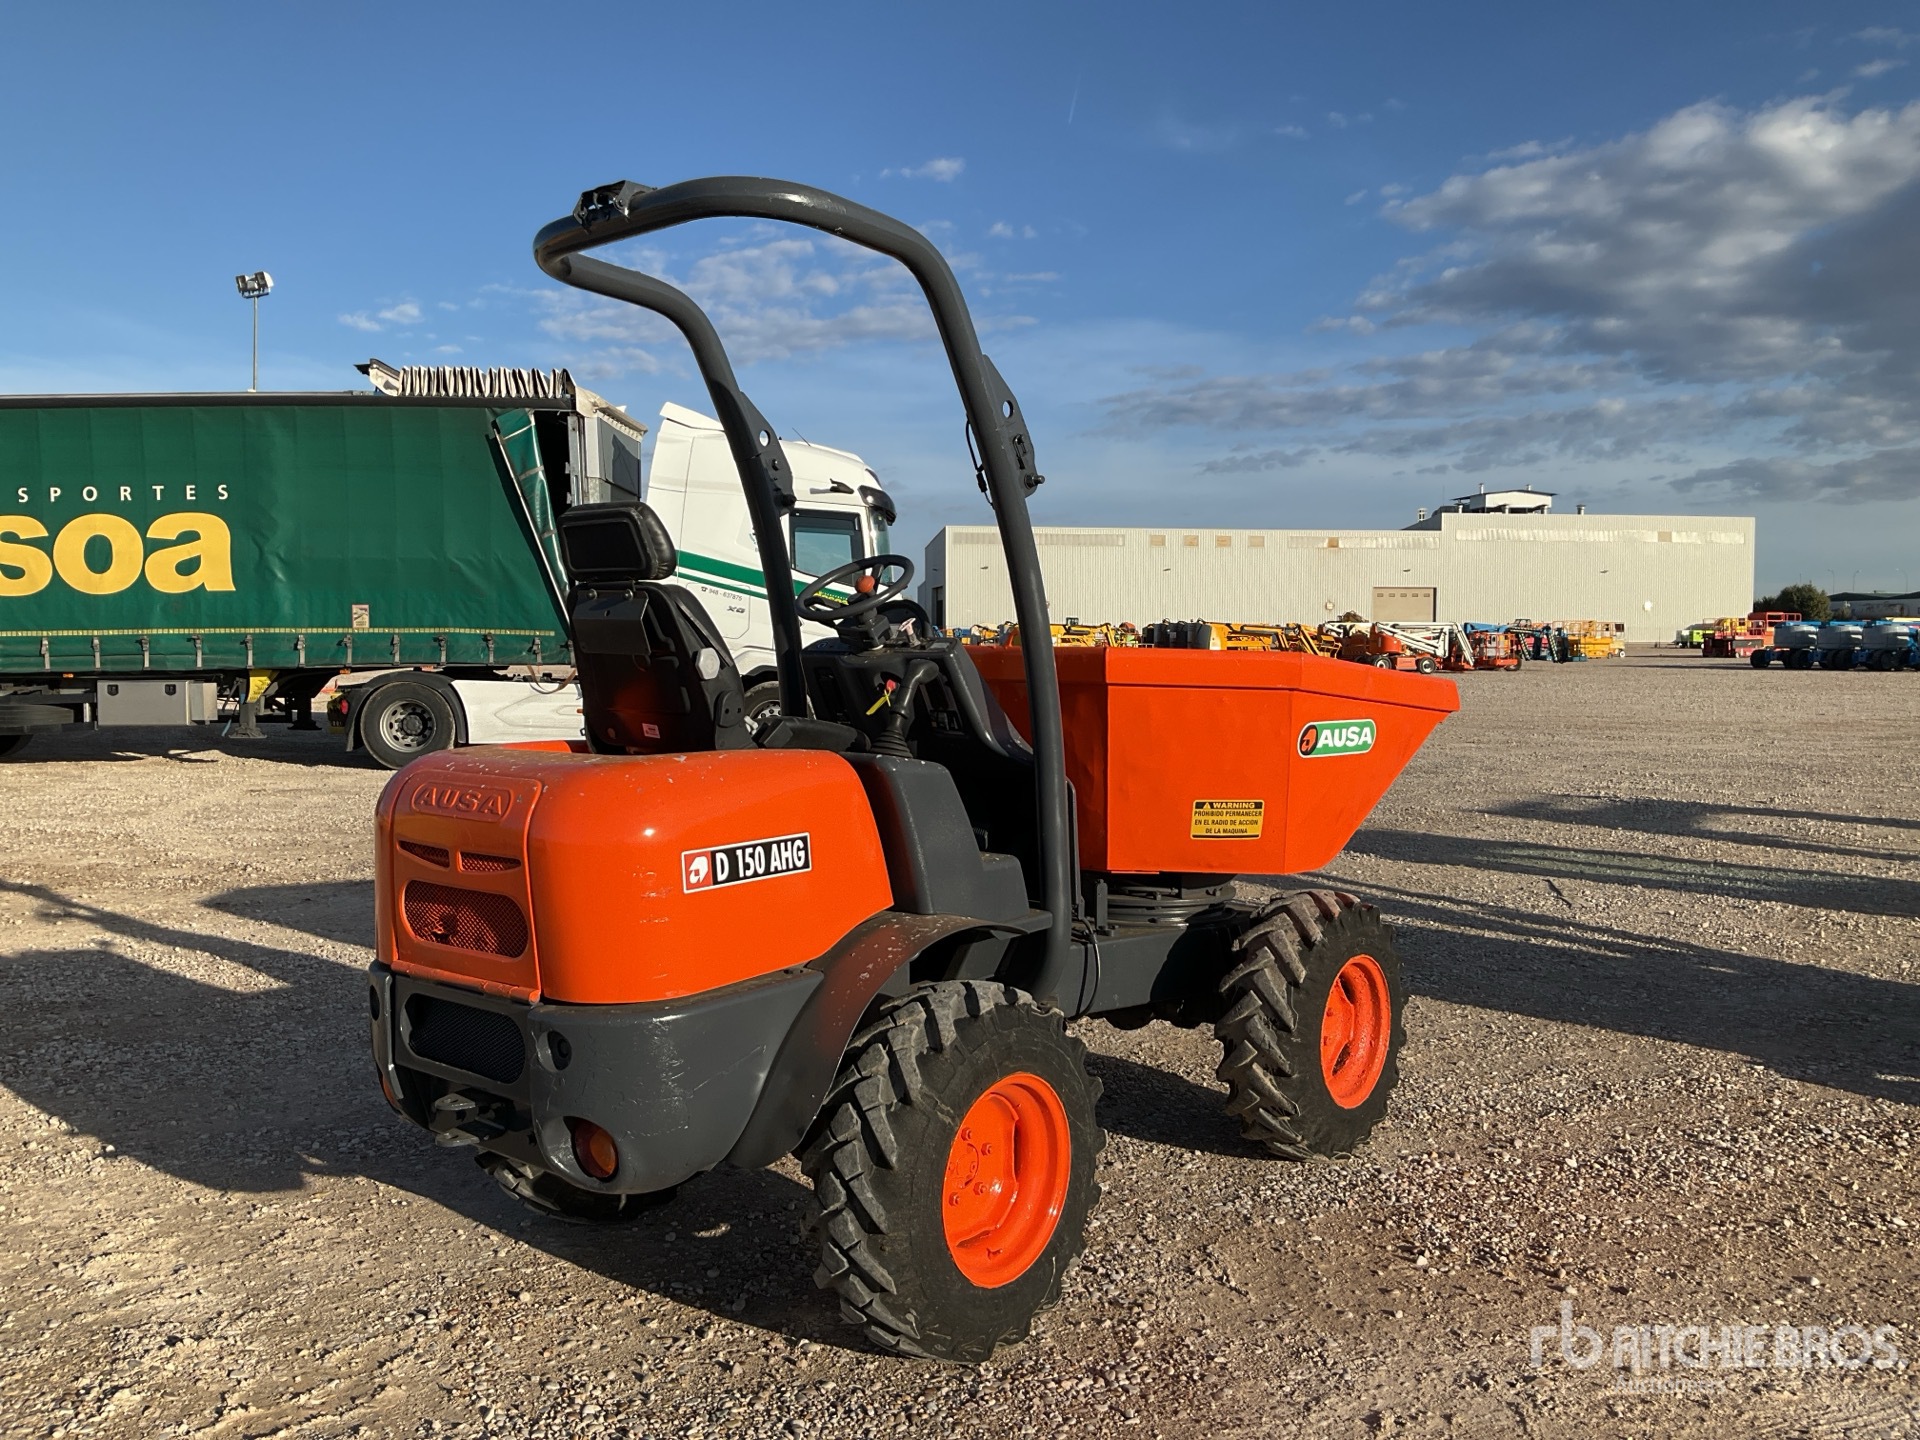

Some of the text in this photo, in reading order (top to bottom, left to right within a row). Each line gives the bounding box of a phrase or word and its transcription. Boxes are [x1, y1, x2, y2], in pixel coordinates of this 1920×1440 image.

[1316, 726, 1372, 748] AUSA
[415, 787, 502, 815] AUSA
[715, 839, 806, 882] D 150 AHG
